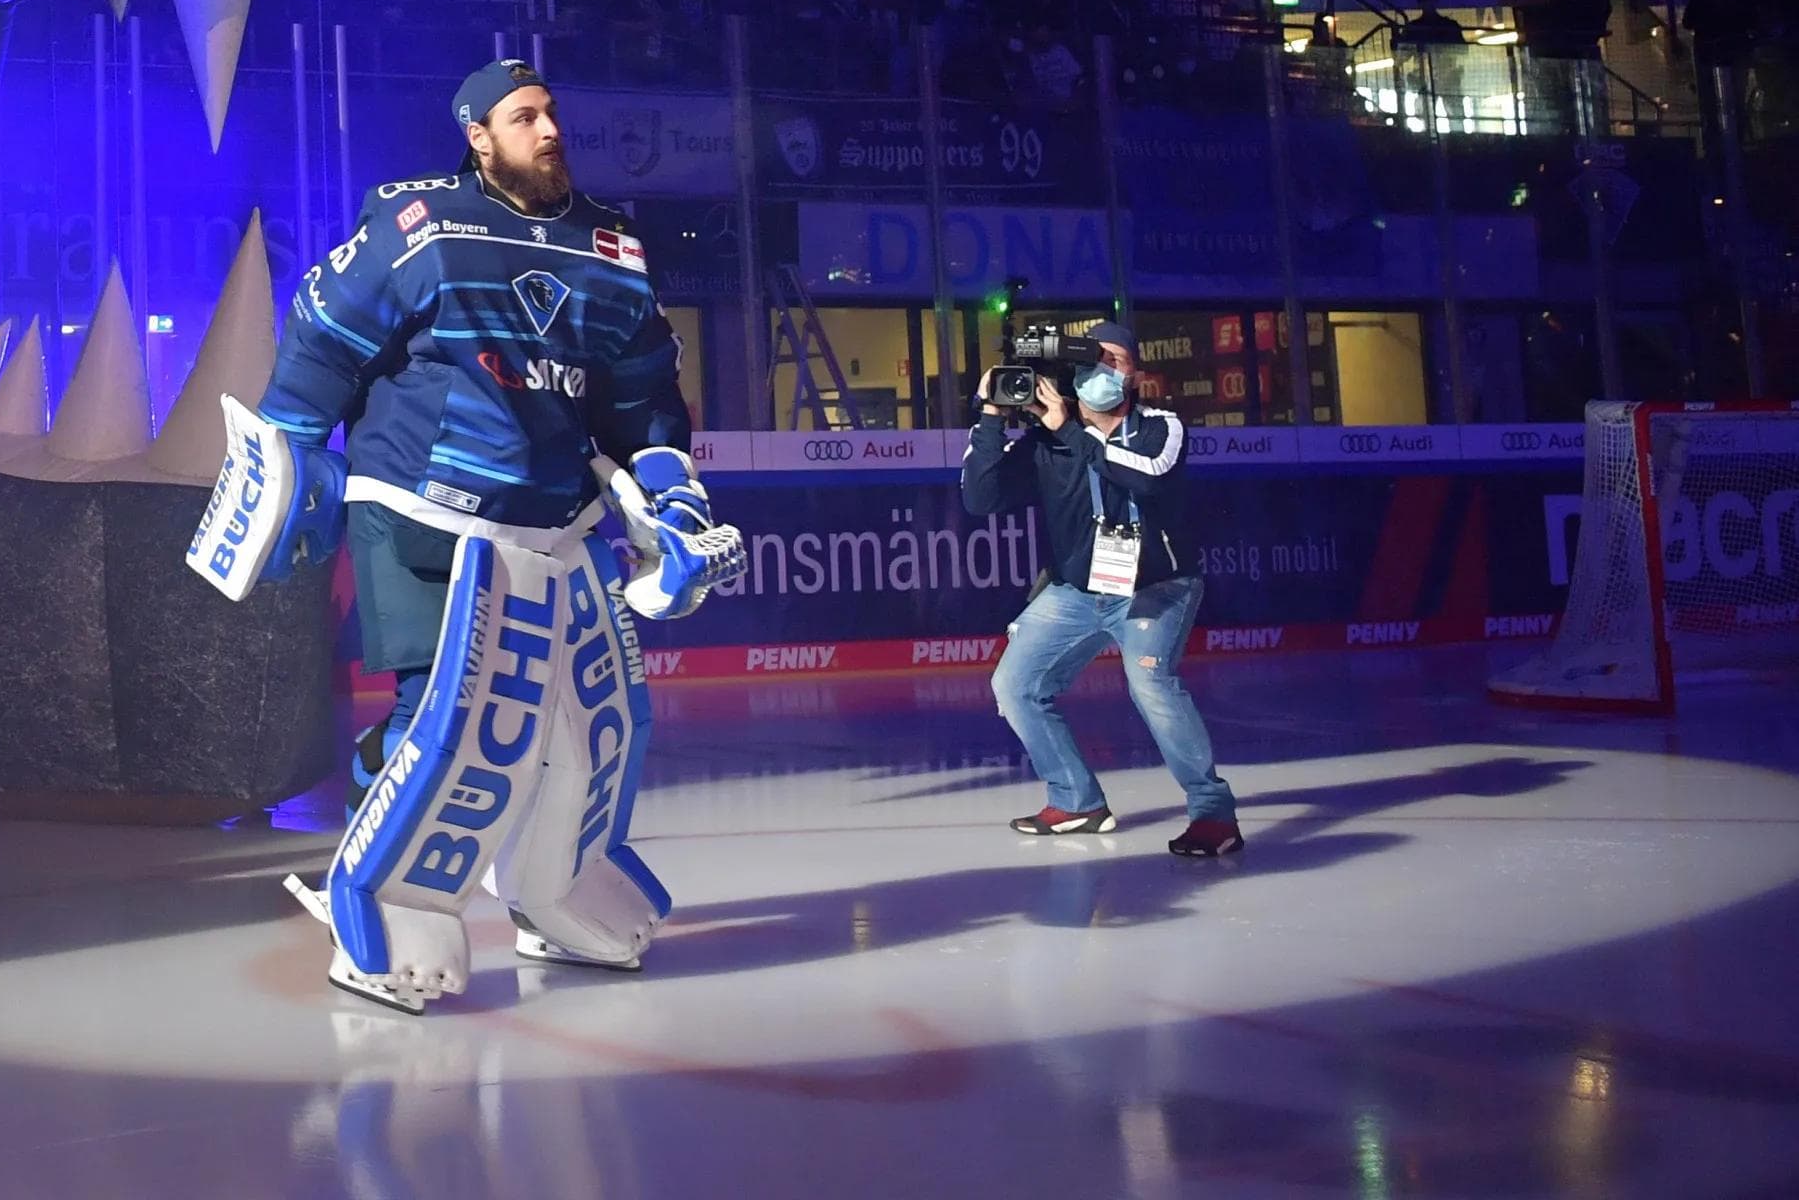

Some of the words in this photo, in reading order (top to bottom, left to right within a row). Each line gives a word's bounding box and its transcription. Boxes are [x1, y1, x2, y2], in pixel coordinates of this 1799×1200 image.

[999, 121, 1043, 178] 99
[406, 220, 440, 248] Regio
[442, 219, 489, 235] Bayern
[1138, 337, 1193, 362] ARTNER
[696, 442, 714, 460] di
[863, 440, 915, 460] Audi
[1225, 435, 1272, 455] Audi
[1389, 433, 1433, 452] Audi
[1547, 431, 1585, 450] Aud
[187, 453, 235, 557] VAUGHN
[1198, 539, 1260, 581] assig
[1271, 535, 1339, 573] mobil
[606, 578, 646, 685] VAUGHN
[1346, 620, 1422, 645] PENNY
[1483, 614, 1554, 638] PENNY
[912, 637, 998, 664] PENNY
[1205, 627, 1284, 651] PENNY
[746, 645, 837, 672] PENNY
[343, 739, 422, 875] VAUGHN
